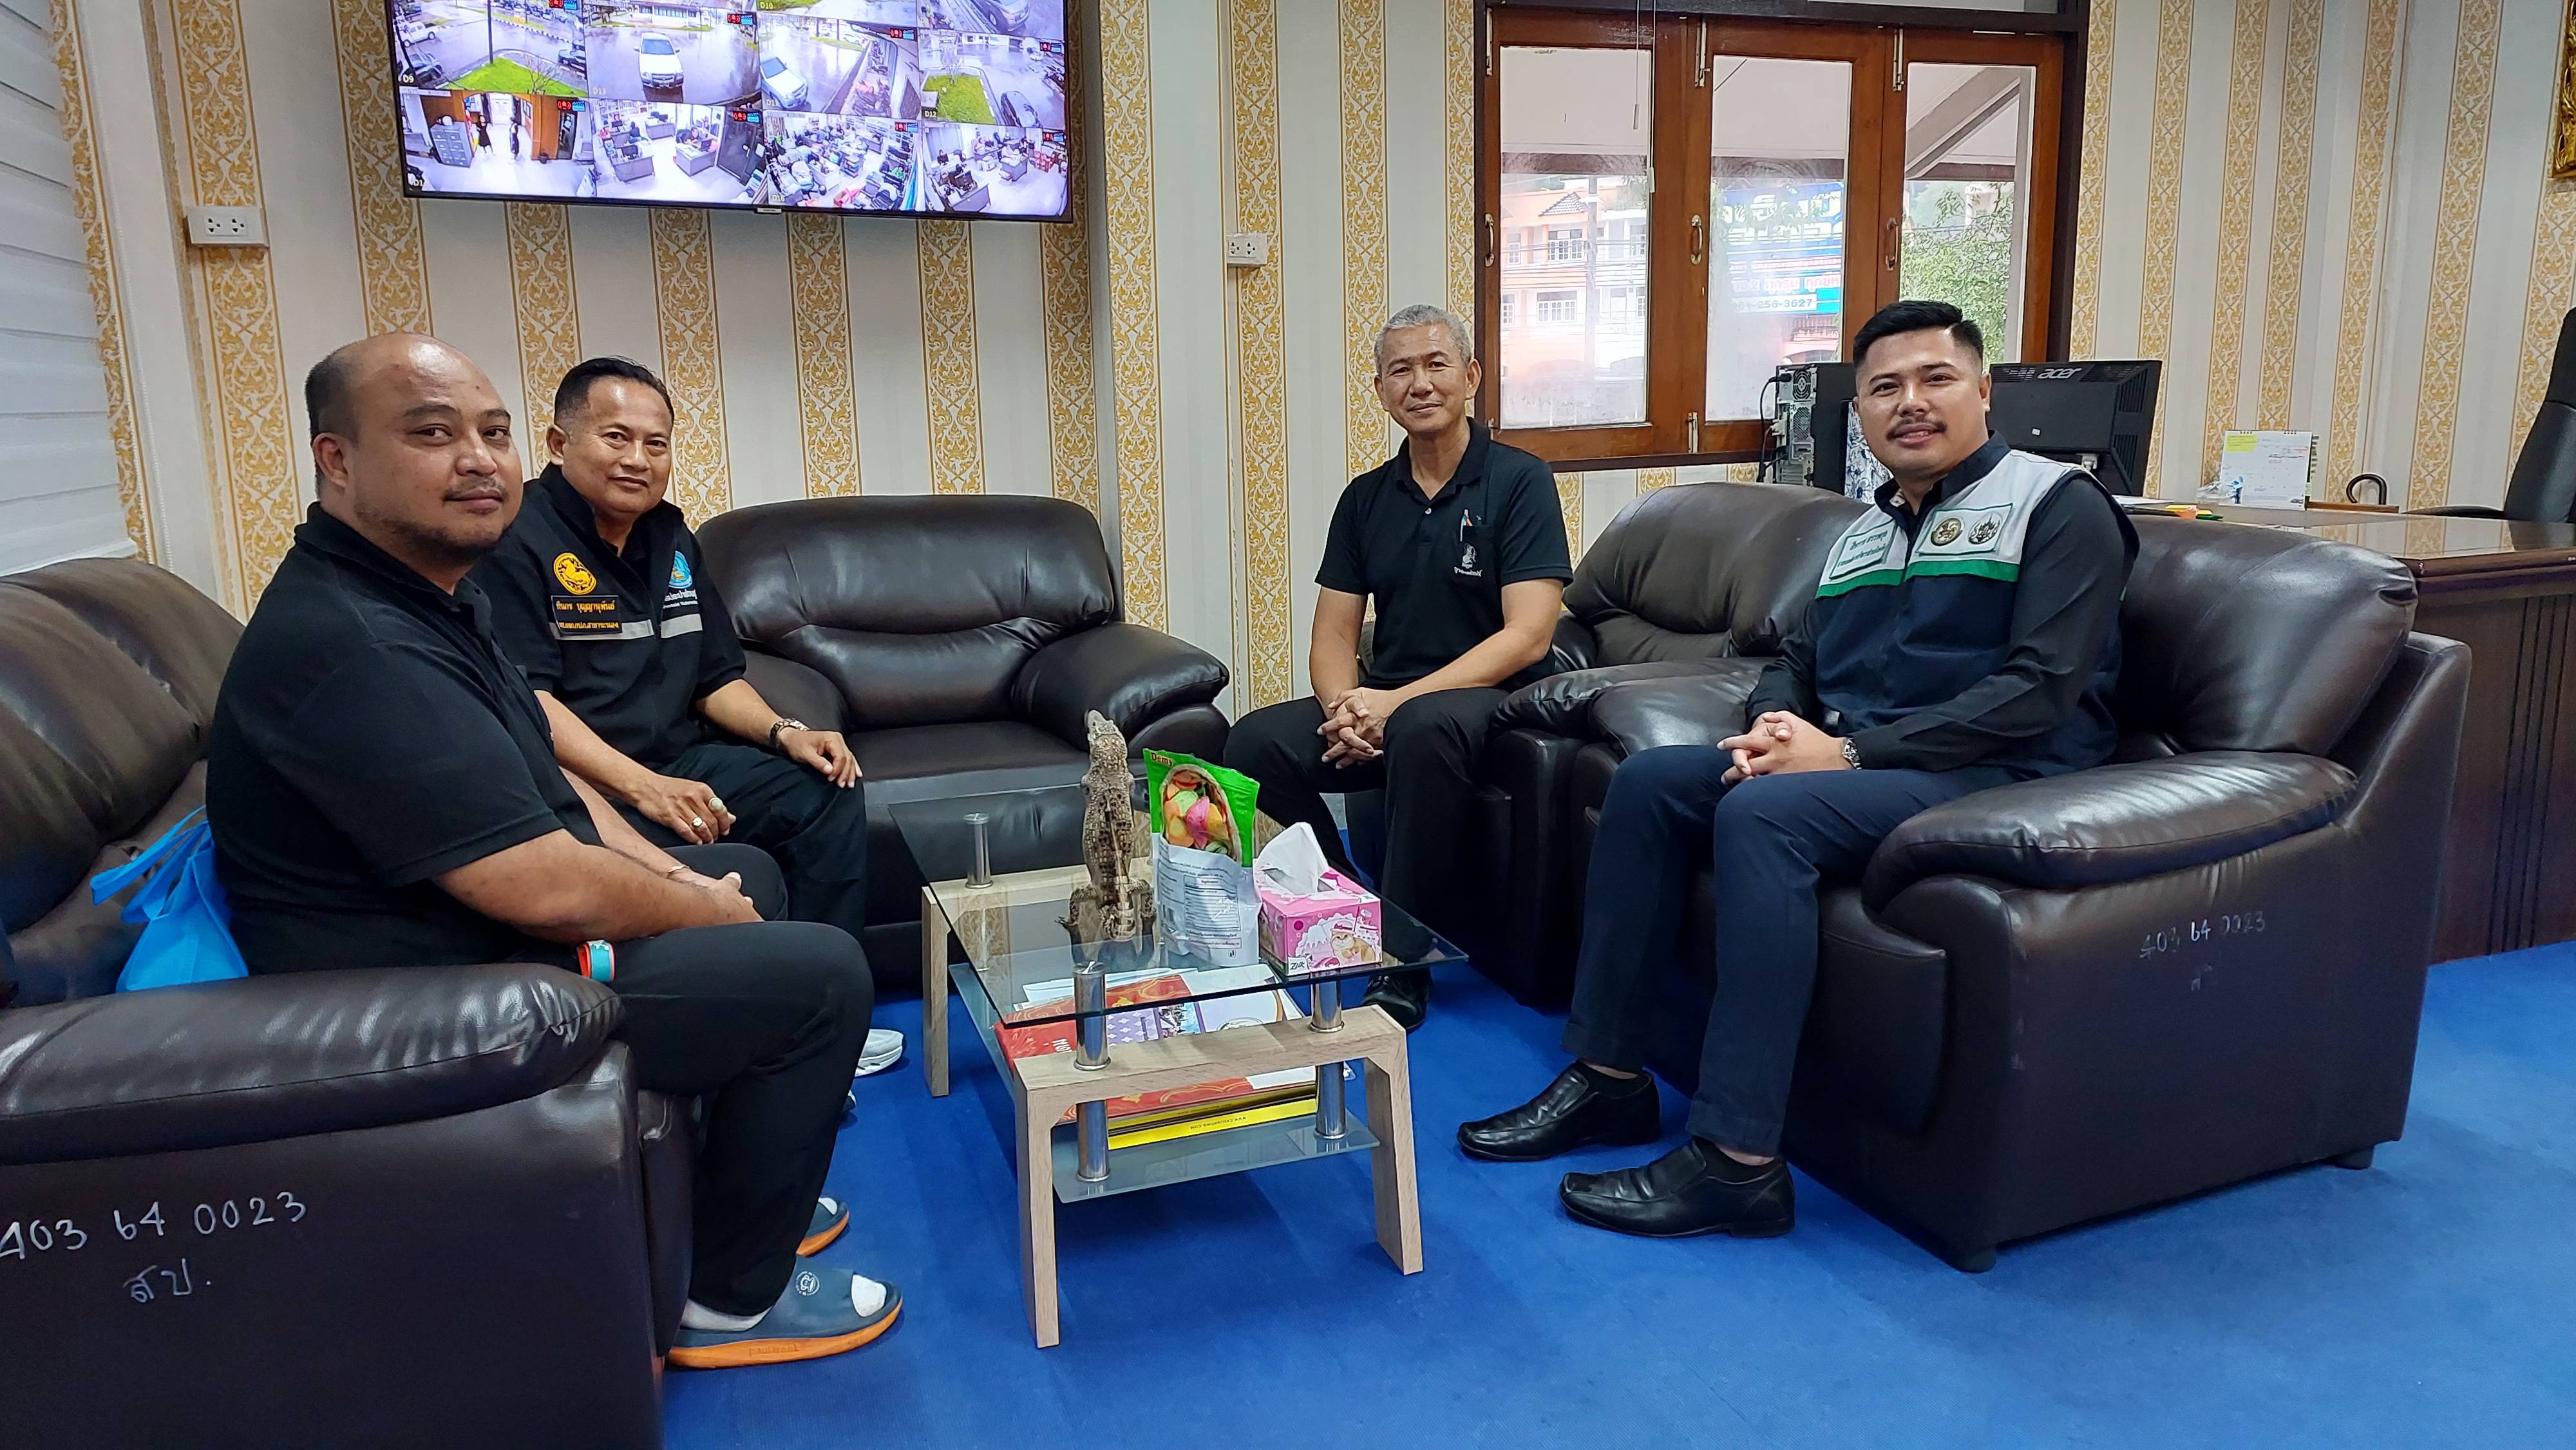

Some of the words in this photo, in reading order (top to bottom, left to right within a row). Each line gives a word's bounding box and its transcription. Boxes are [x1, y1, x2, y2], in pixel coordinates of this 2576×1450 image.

[760, 1, 773, 10] D10
[402, 73, 415, 83] D9
[2038, 368, 2082, 379] acer
[194, 1191, 306, 1234] 0023
